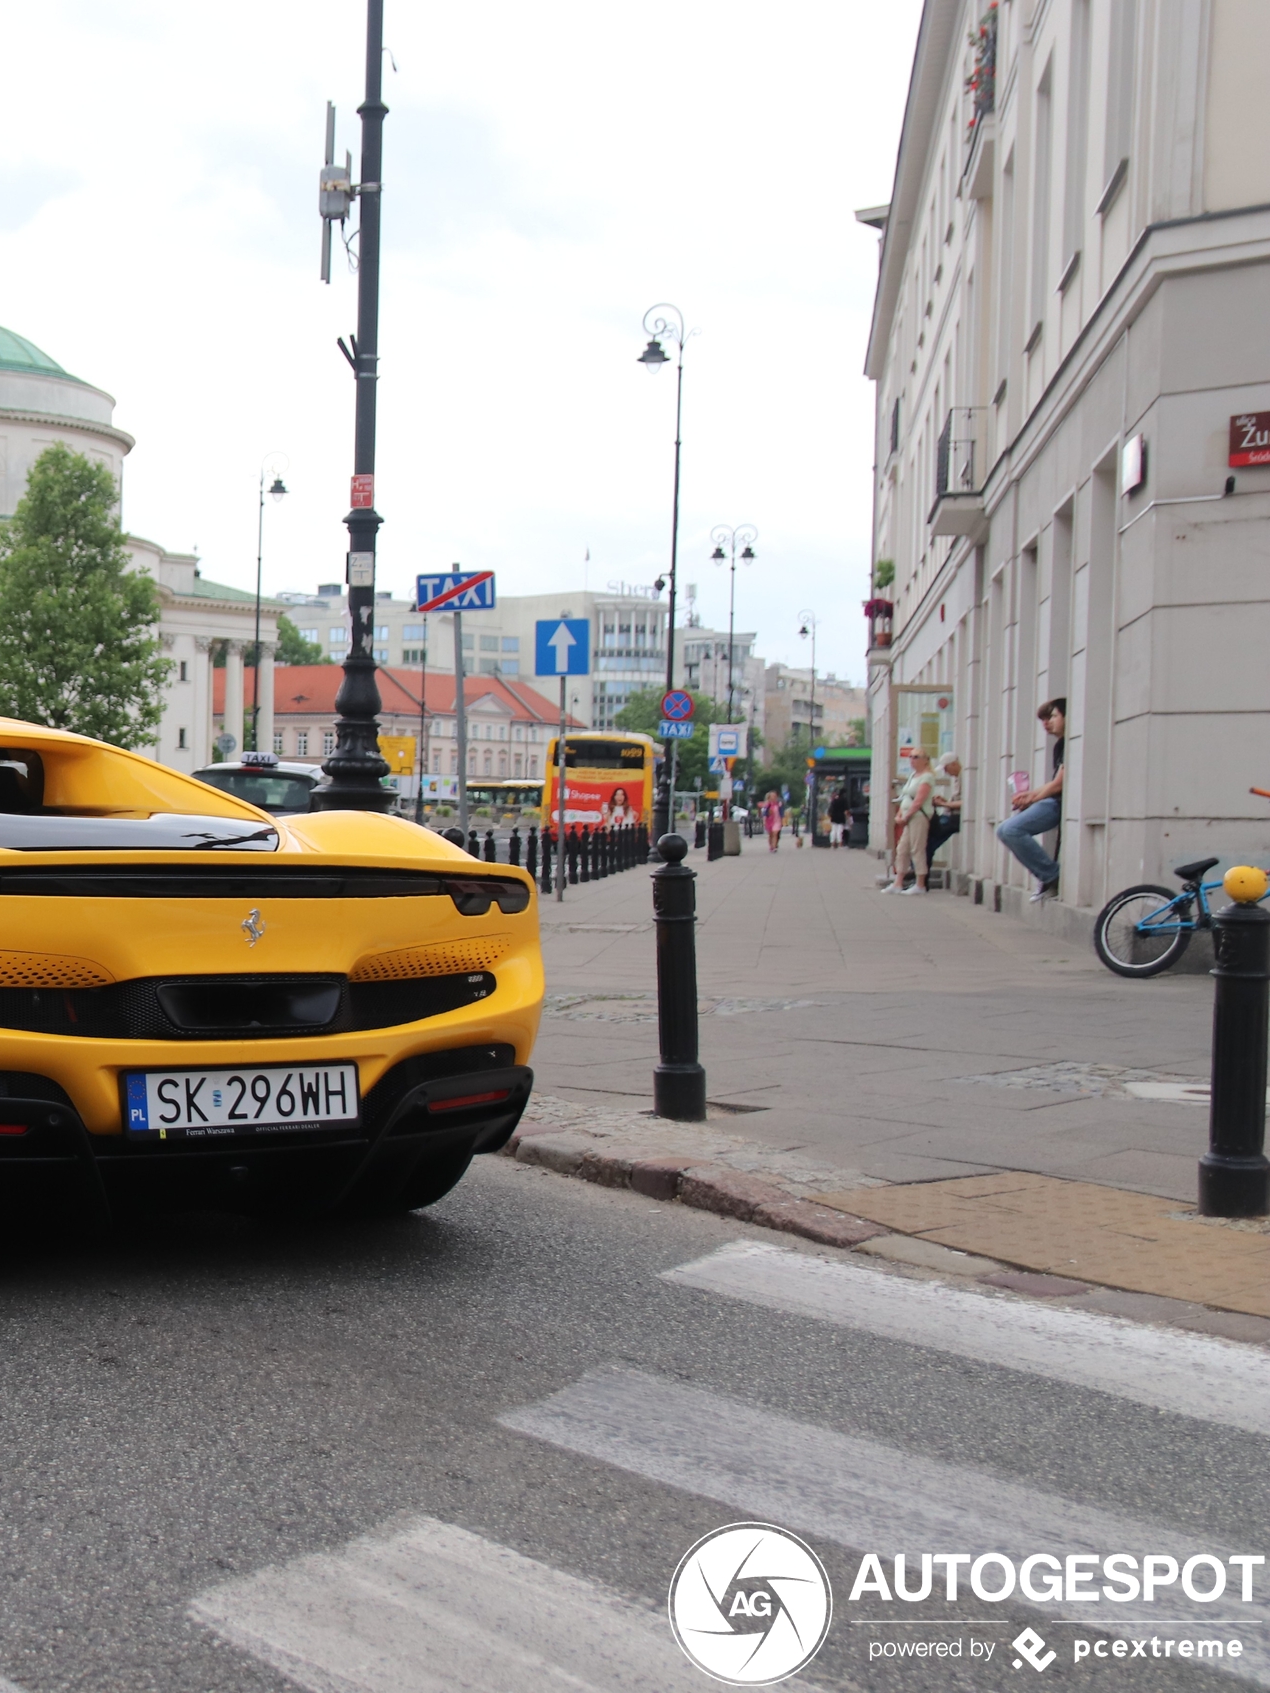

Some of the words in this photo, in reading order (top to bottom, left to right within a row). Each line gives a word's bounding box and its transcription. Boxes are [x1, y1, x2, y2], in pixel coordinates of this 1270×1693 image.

[420, 576, 492, 607] TAXI
[661, 721, 691, 738] TAXI
[245, 753, 271, 763] TAXI
[570, 789, 602, 803] Shopee
[157, 1077, 209, 1124] SK
[226, 1071, 347, 1121] 296WH
[131, 1108, 146, 1122] PL
[186, 1128, 206, 1137] Ferrari
[207, 1127, 235, 1135] Warszawa
